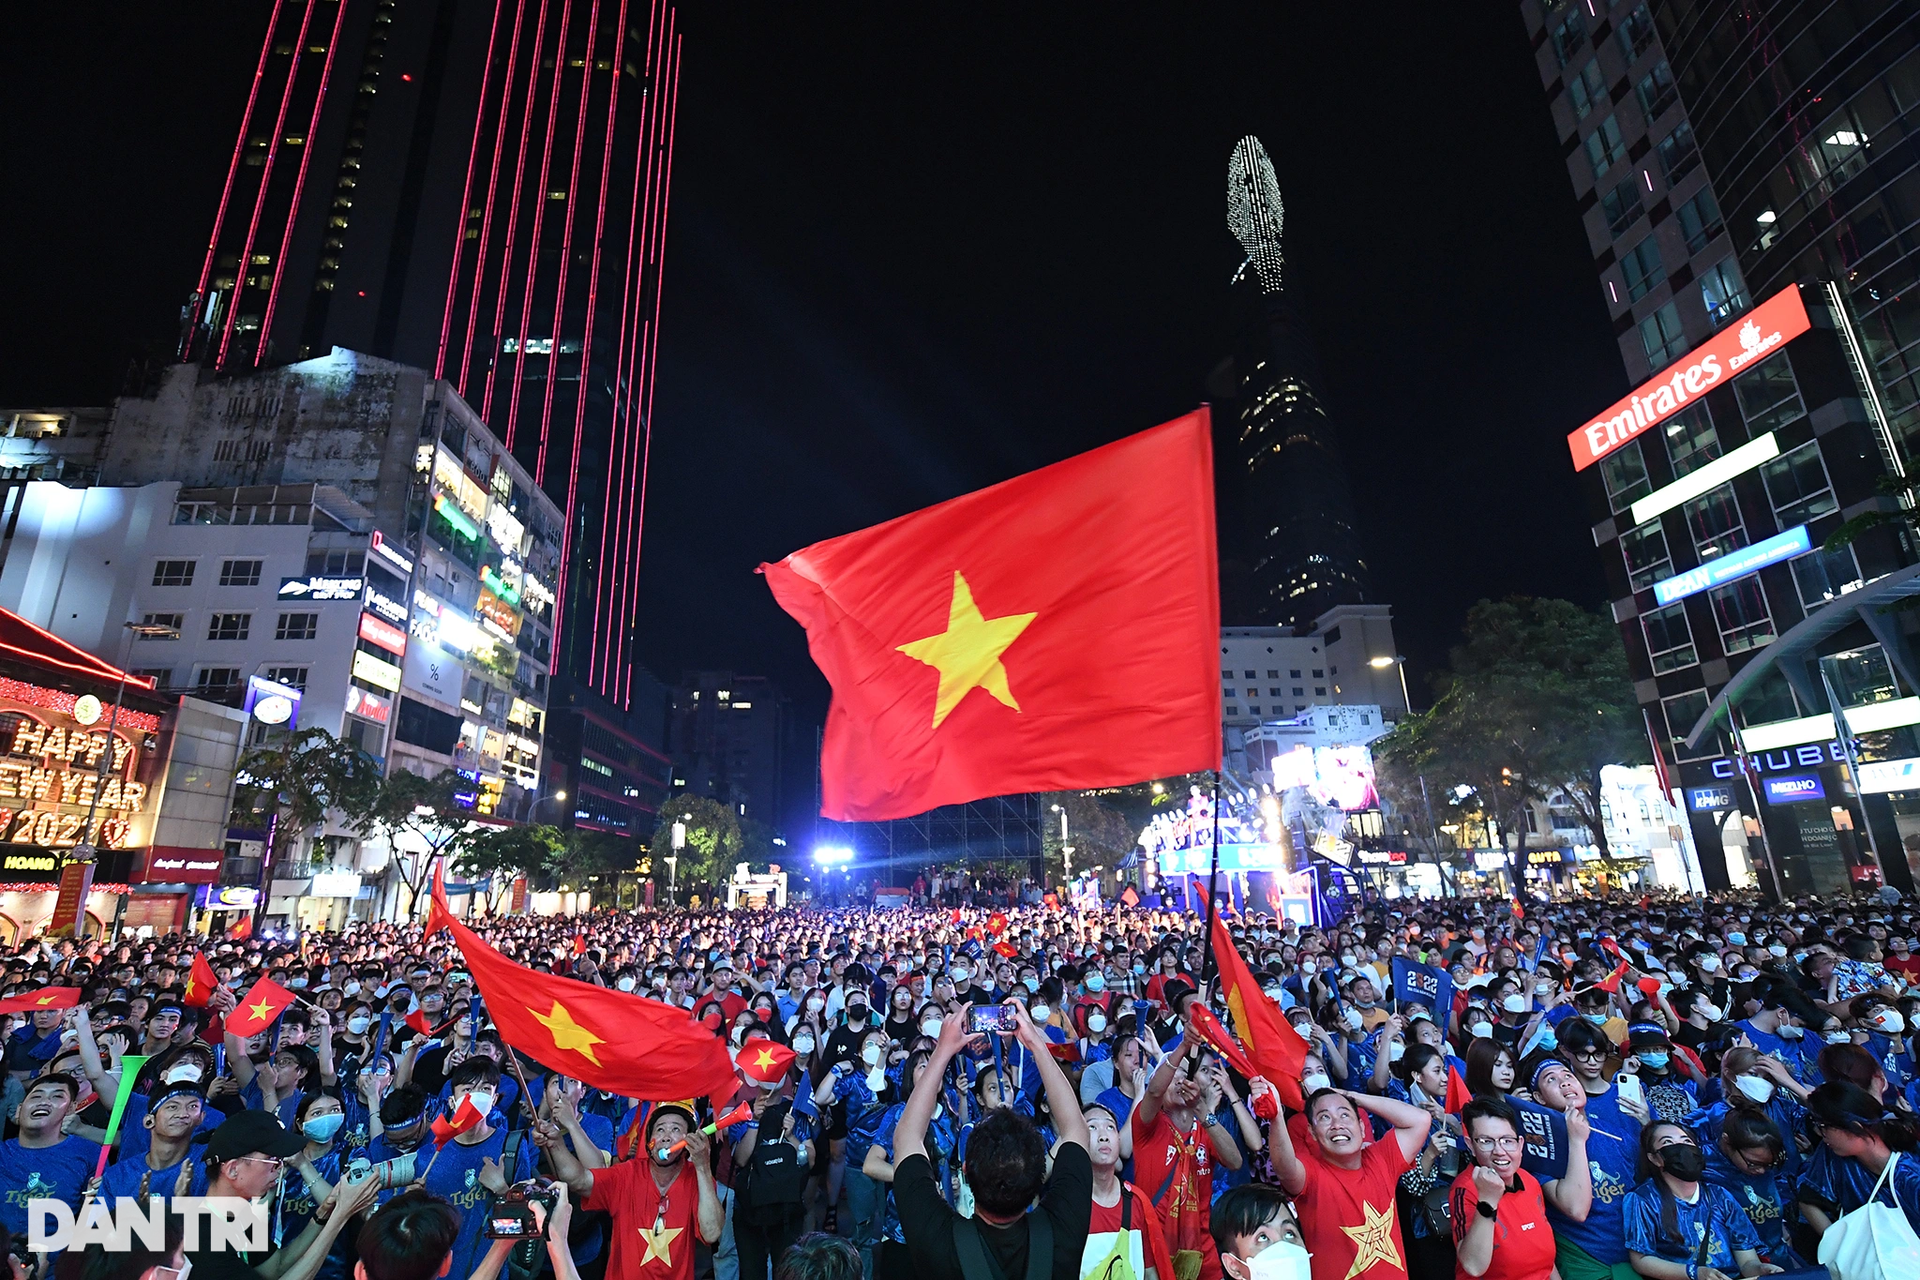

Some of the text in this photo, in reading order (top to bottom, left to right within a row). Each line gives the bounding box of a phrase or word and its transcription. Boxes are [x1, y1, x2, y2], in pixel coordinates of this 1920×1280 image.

[1728, 331, 1782, 370] Emirates
[1584, 354, 1722, 456] Emirates
[13, 719, 132, 770] HAPPY
[1711, 740, 1858, 779] CHUBB
[0, 762, 147, 811] EW YEAR
[1695, 794, 1729, 808] KPMG
[1528, 851, 1562, 863] GUTA
[5, 1188, 56, 1209] Tiger
[450, 1186, 488, 1210] Tiger
